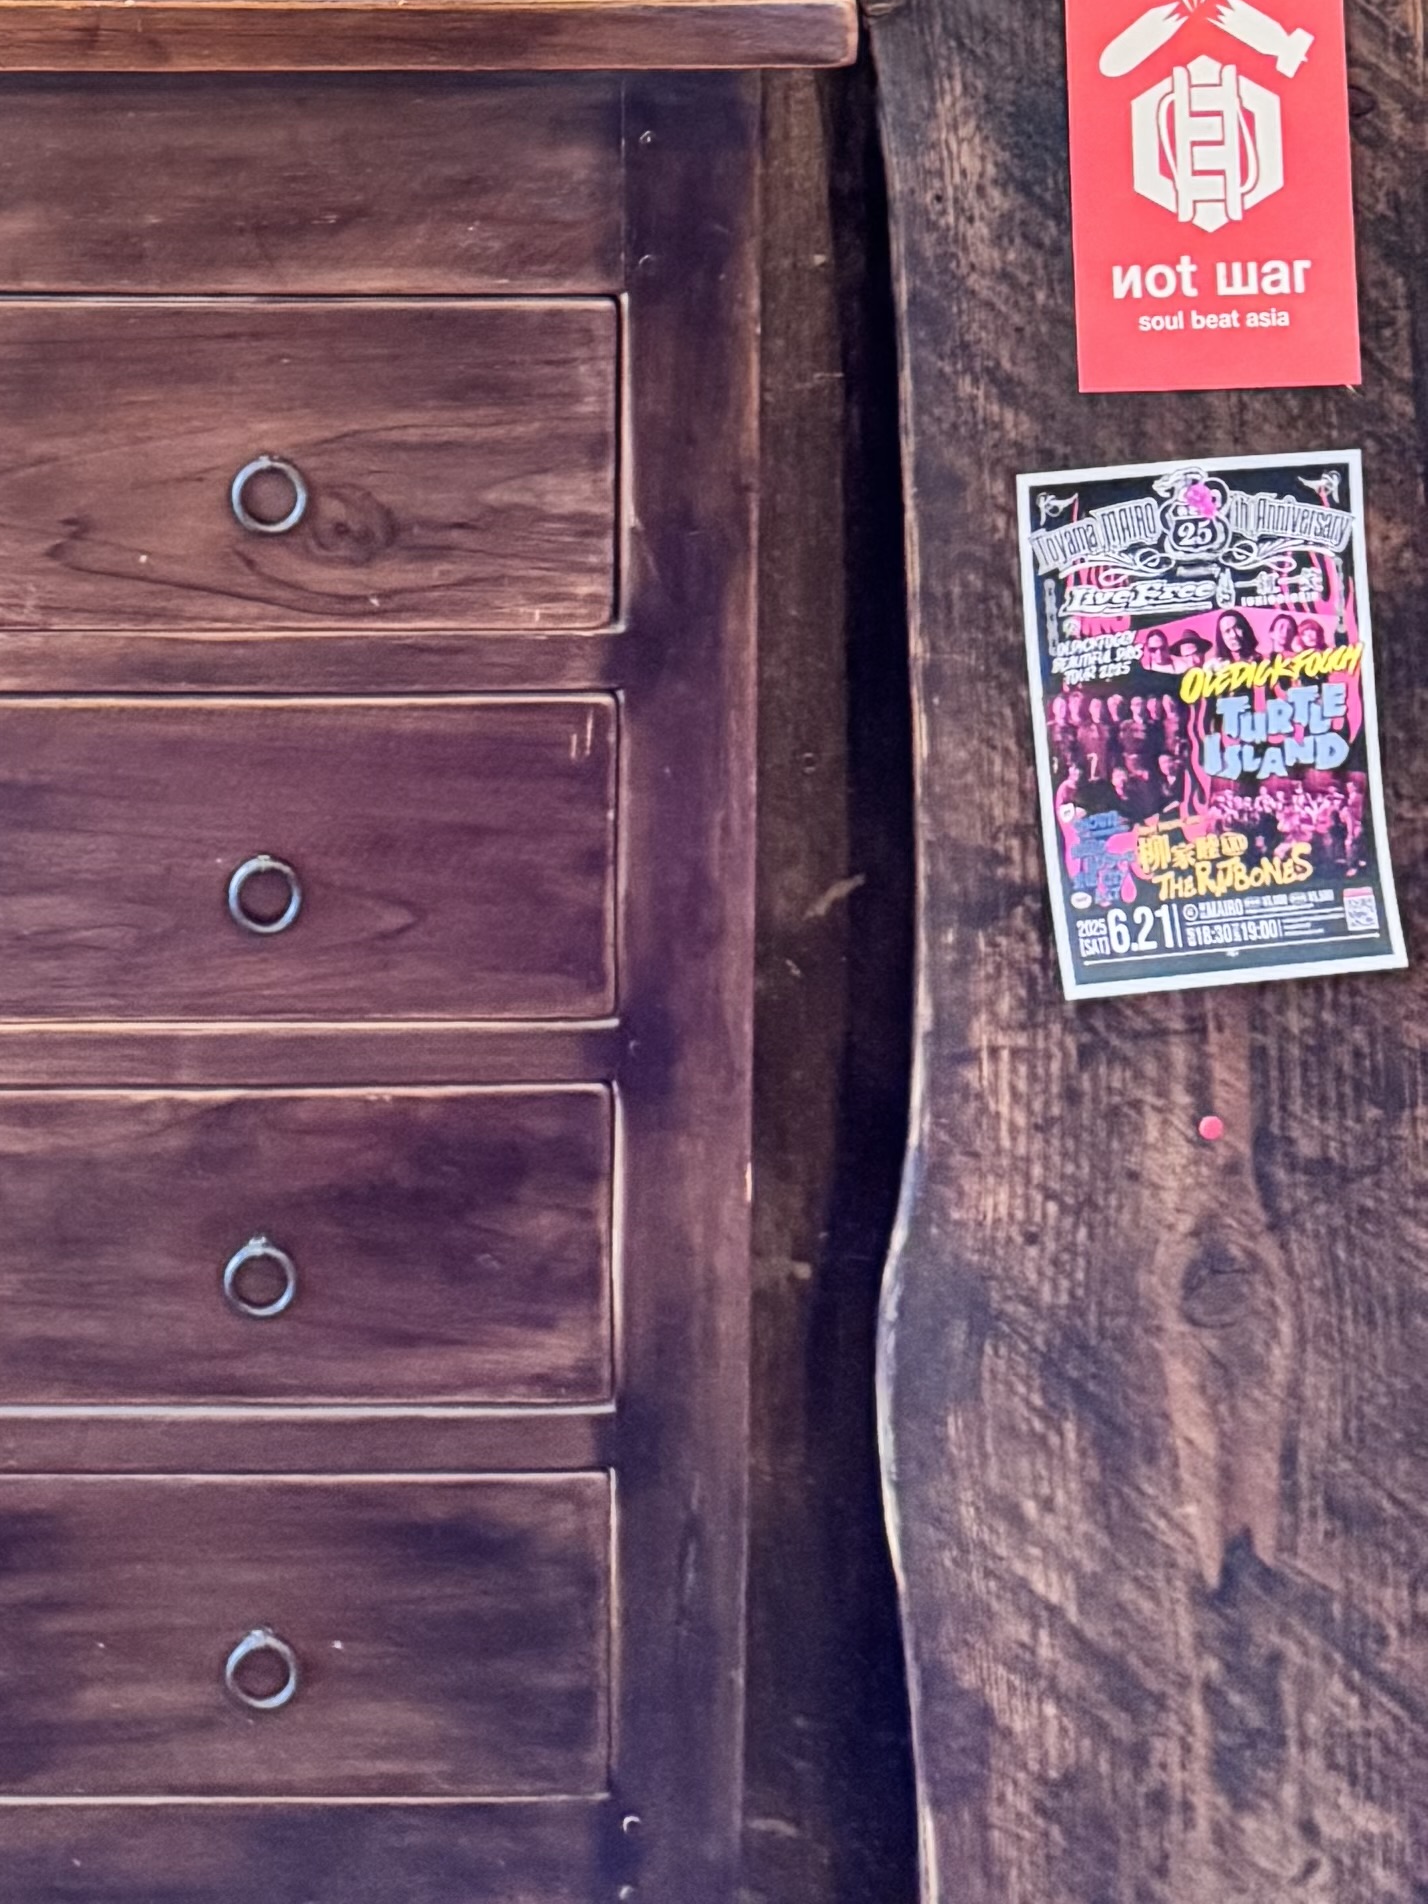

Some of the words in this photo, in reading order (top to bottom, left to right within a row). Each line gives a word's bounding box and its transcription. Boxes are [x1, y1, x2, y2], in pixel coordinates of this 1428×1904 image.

[1139, 310, 1184, 332] soul
[1191, 308, 1240, 329] beat
[1246, 306, 1290, 329] asia
[1035, 519, 1097, 565] Toyama
[1101, 502, 1159, 547] MAIRO
[1177, 520, 1213, 546] 25
[1256, 498, 1351, 548] Anniversary
[1063, 665, 1097, 686] TOUR
[1216, 682, 1347, 744] TURTLE
[1203, 732, 1350, 780] ISLAND
[1151, 870, 1197, 902] THE
[1076, 918, 1107, 937] 2025
[1107, 903, 1174, 955] 6.21
[1196, 923, 1233, 946] 18:30
[1241, 918, 1278, 943] 19:00
